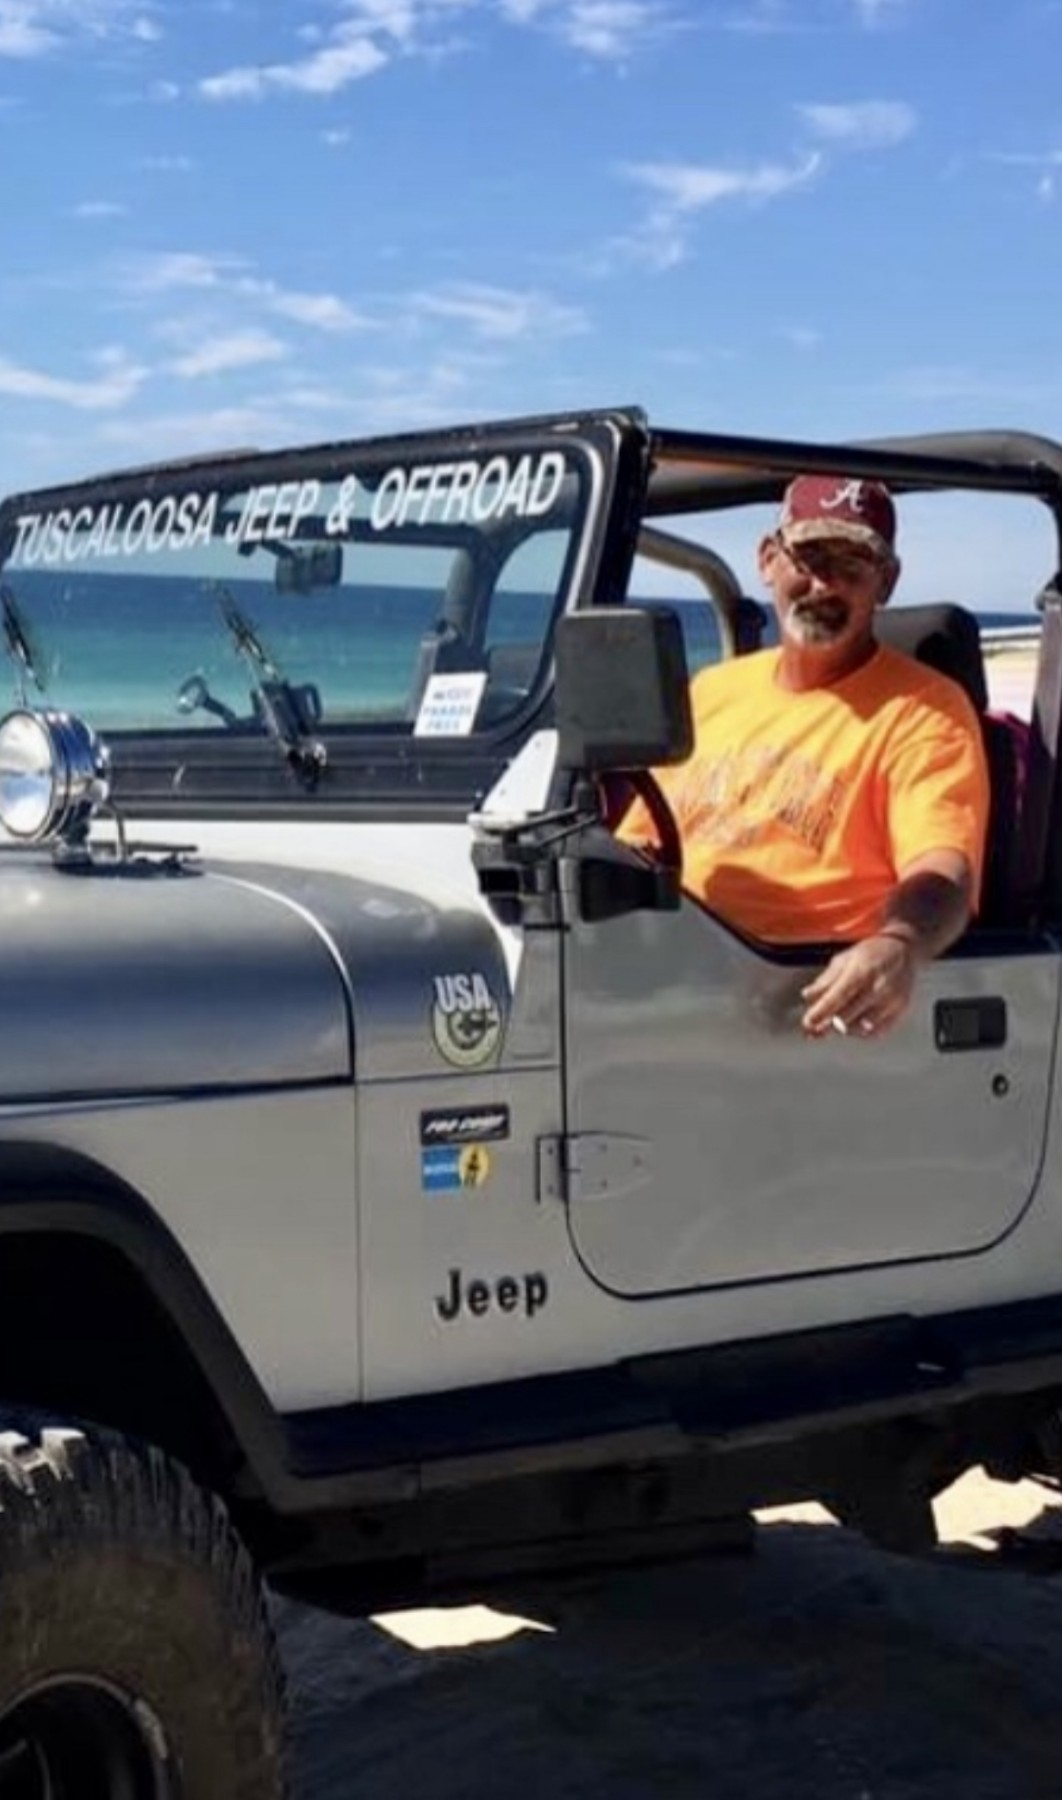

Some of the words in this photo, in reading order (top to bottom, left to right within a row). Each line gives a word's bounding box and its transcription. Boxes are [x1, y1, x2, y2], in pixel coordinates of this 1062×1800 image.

[9, 492, 218, 566] TUSCALOOSA
[225, 480, 321, 544] JEEP
[325, 474, 356, 535] &
[370, 452, 565, 531] OFFROAD
[820, 479, 863, 513] A
[434, 973, 491, 1013] USA
[436, 1268, 548, 1321] Jeep
